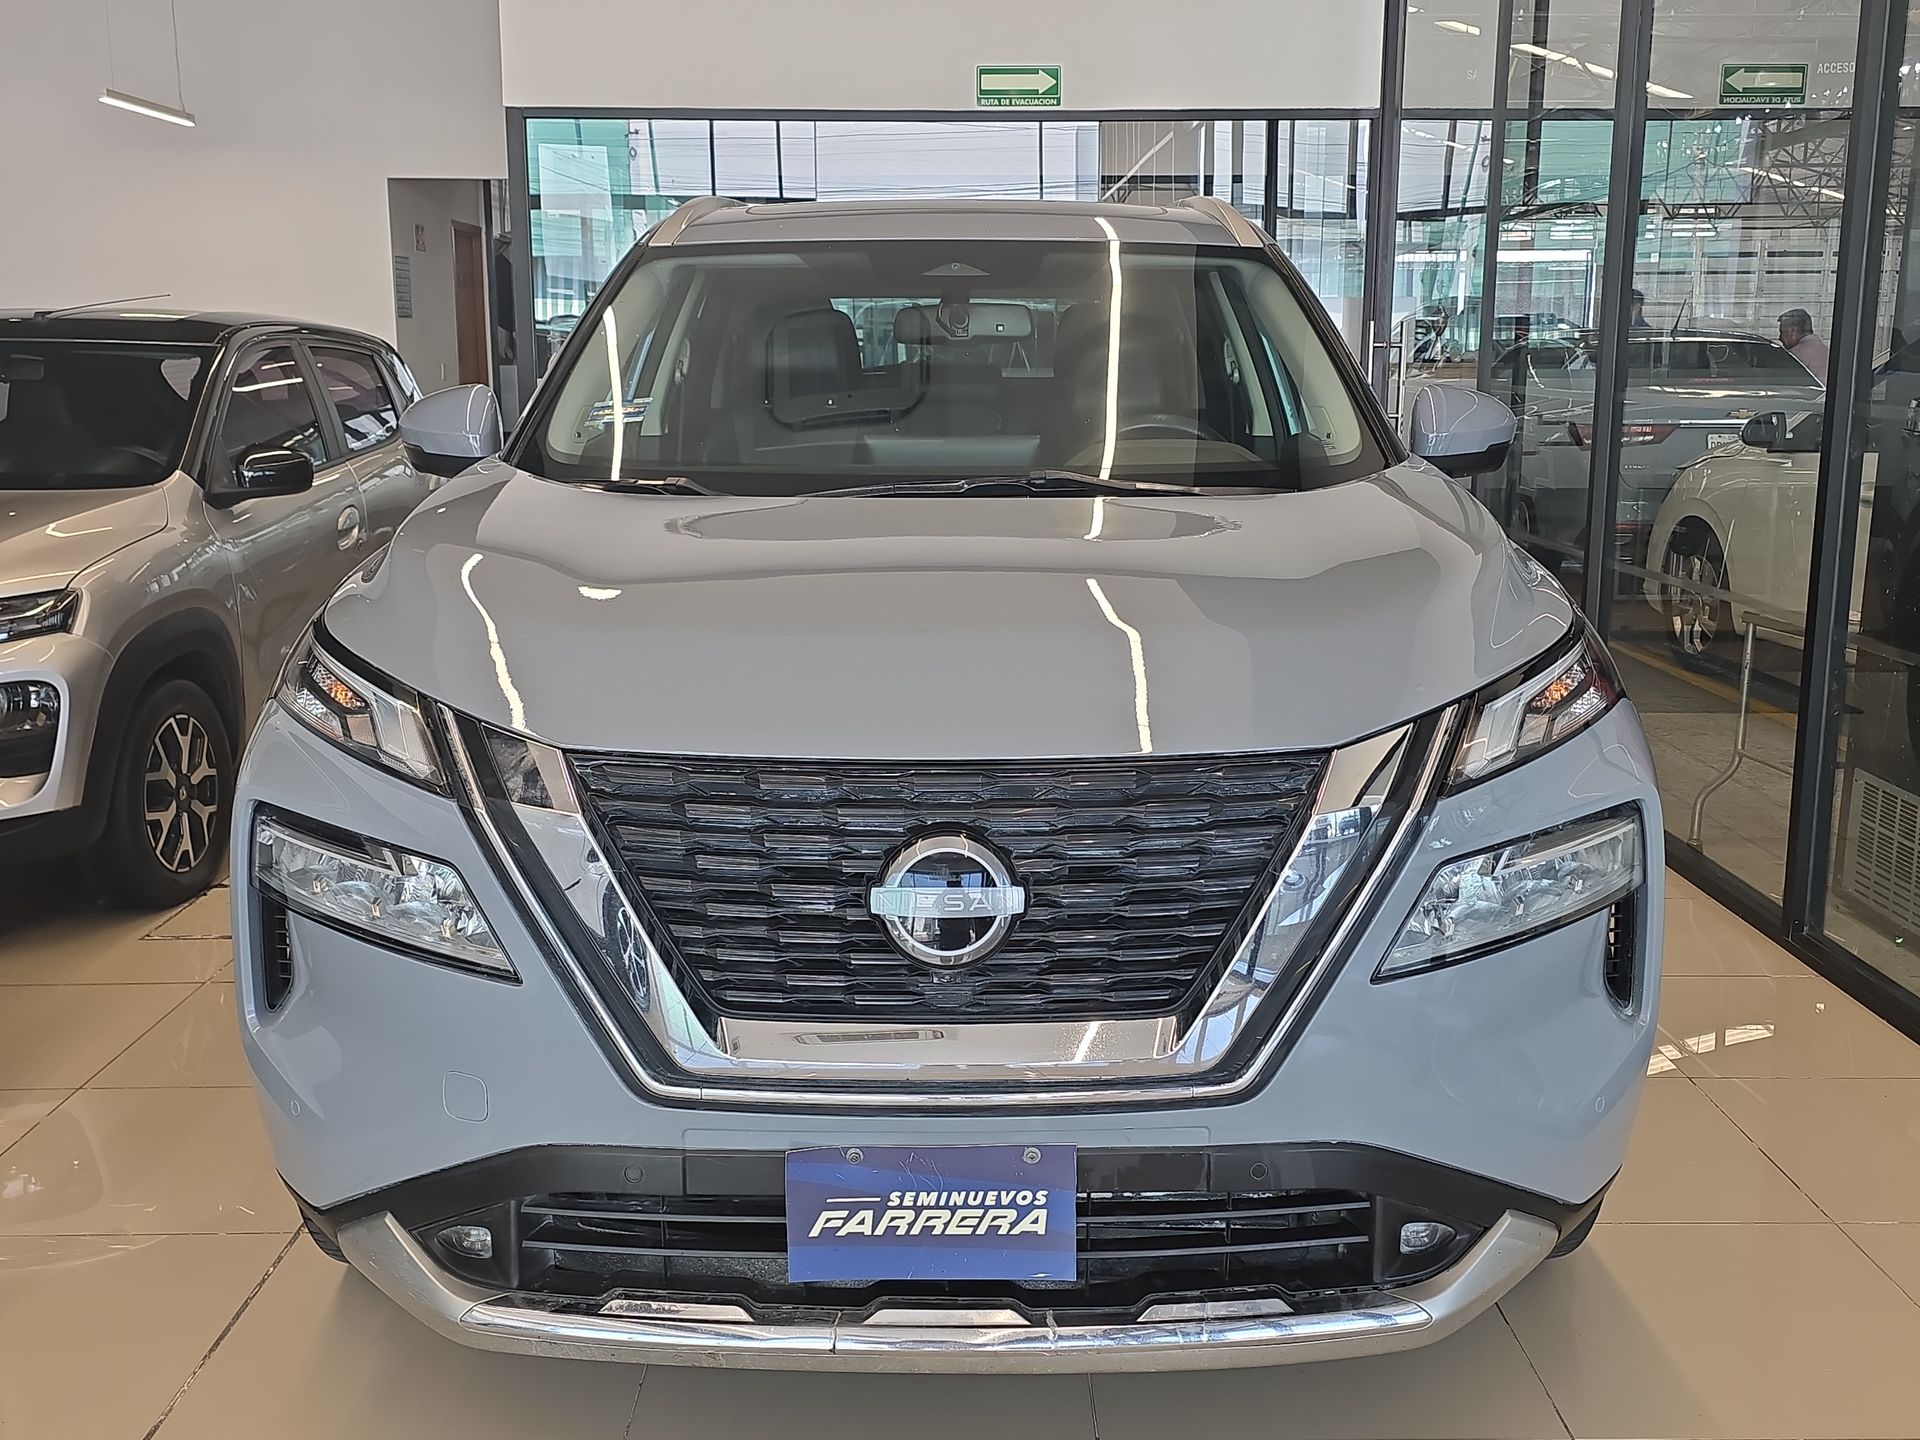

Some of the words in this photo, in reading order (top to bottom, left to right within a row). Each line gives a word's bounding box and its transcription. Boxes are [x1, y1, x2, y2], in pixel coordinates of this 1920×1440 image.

[1816, 62, 1855, 75] ACCESO
[980, 98, 999, 106] RUTA
[1000, 98, 1010, 106] DE
[1011, 98, 1057, 106] EVACUACION
[886, 1189, 1049, 1208] SEMINUEVOS
[807, 1207, 1050, 1238] FARRERA
